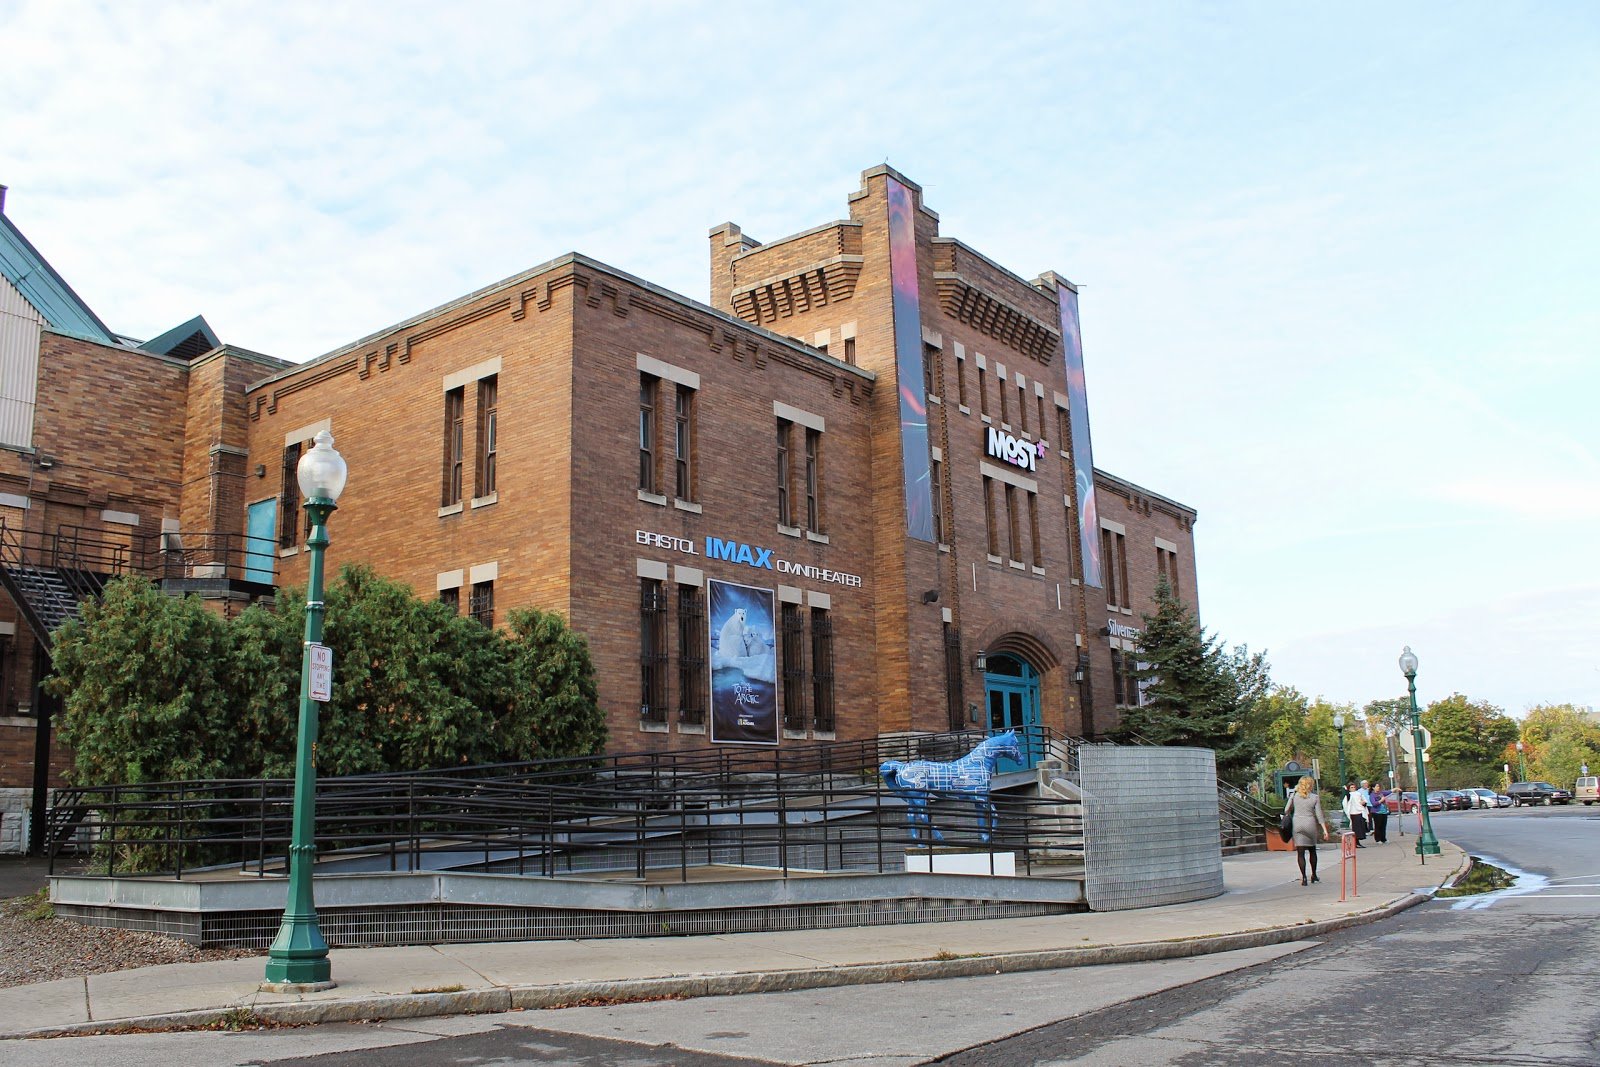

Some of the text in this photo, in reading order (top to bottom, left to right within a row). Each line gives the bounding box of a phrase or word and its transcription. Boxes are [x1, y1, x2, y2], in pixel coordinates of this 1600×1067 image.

[985, 426, 1037, 472] MOST
[636, 529, 862, 588] BRISTOL IMAX OMNITHEATER
[317, 651, 326, 662] NO
[311, 662, 330, 672] STOPPING
[732, 683, 742, 695] TO
